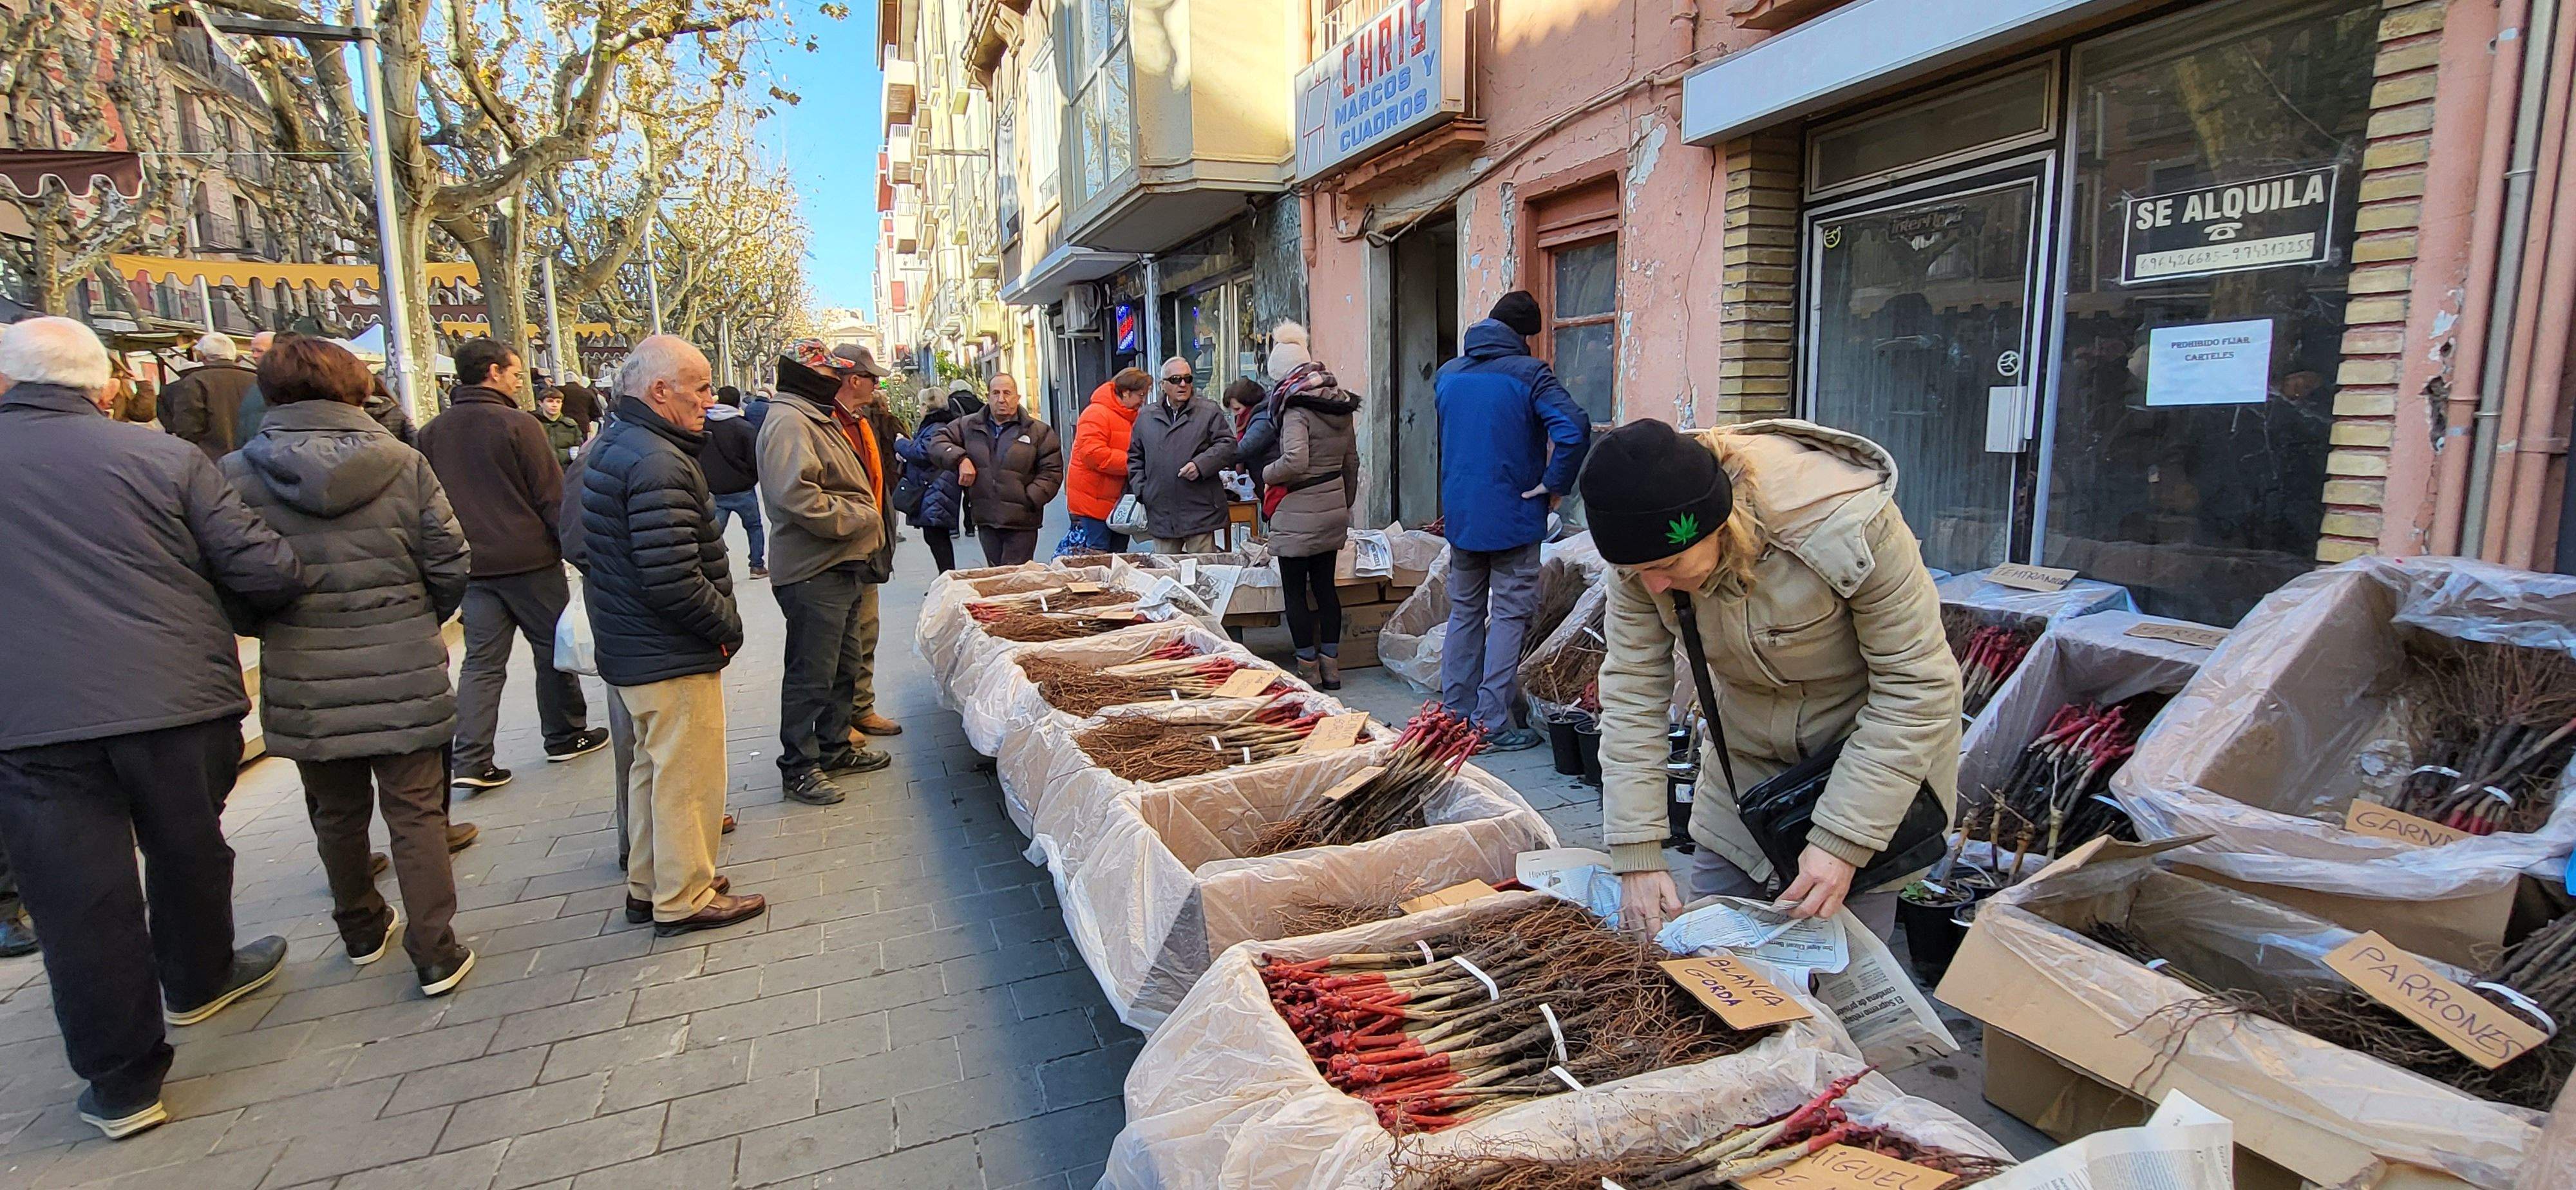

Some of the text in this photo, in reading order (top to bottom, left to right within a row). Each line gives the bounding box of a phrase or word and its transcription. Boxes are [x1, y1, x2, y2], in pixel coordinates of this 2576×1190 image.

[1343, 0, 1426, 99] CHRIS
[1334, 49, 1435, 129] MARCOS Y
[1340, 88, 1428, 153] CUADROS
[2135, 174, 2325, 230] SE ALQUILA
[2171, 336, 2250, 349] PROHIBIDO FIJAR
[2185, 352, 2235, 361] CARTELES
[1685, 968, 1745, 1007] GORDA
[1705, 958, 1785, 1006] BLANCA
[1866, 986, 1896, 1002] condena
[2349, 947, 2525, 1059] PARRONES
[1863, 997, 1897, 1017] Supremo
[1759, 1166, 1810, 1186] DE
